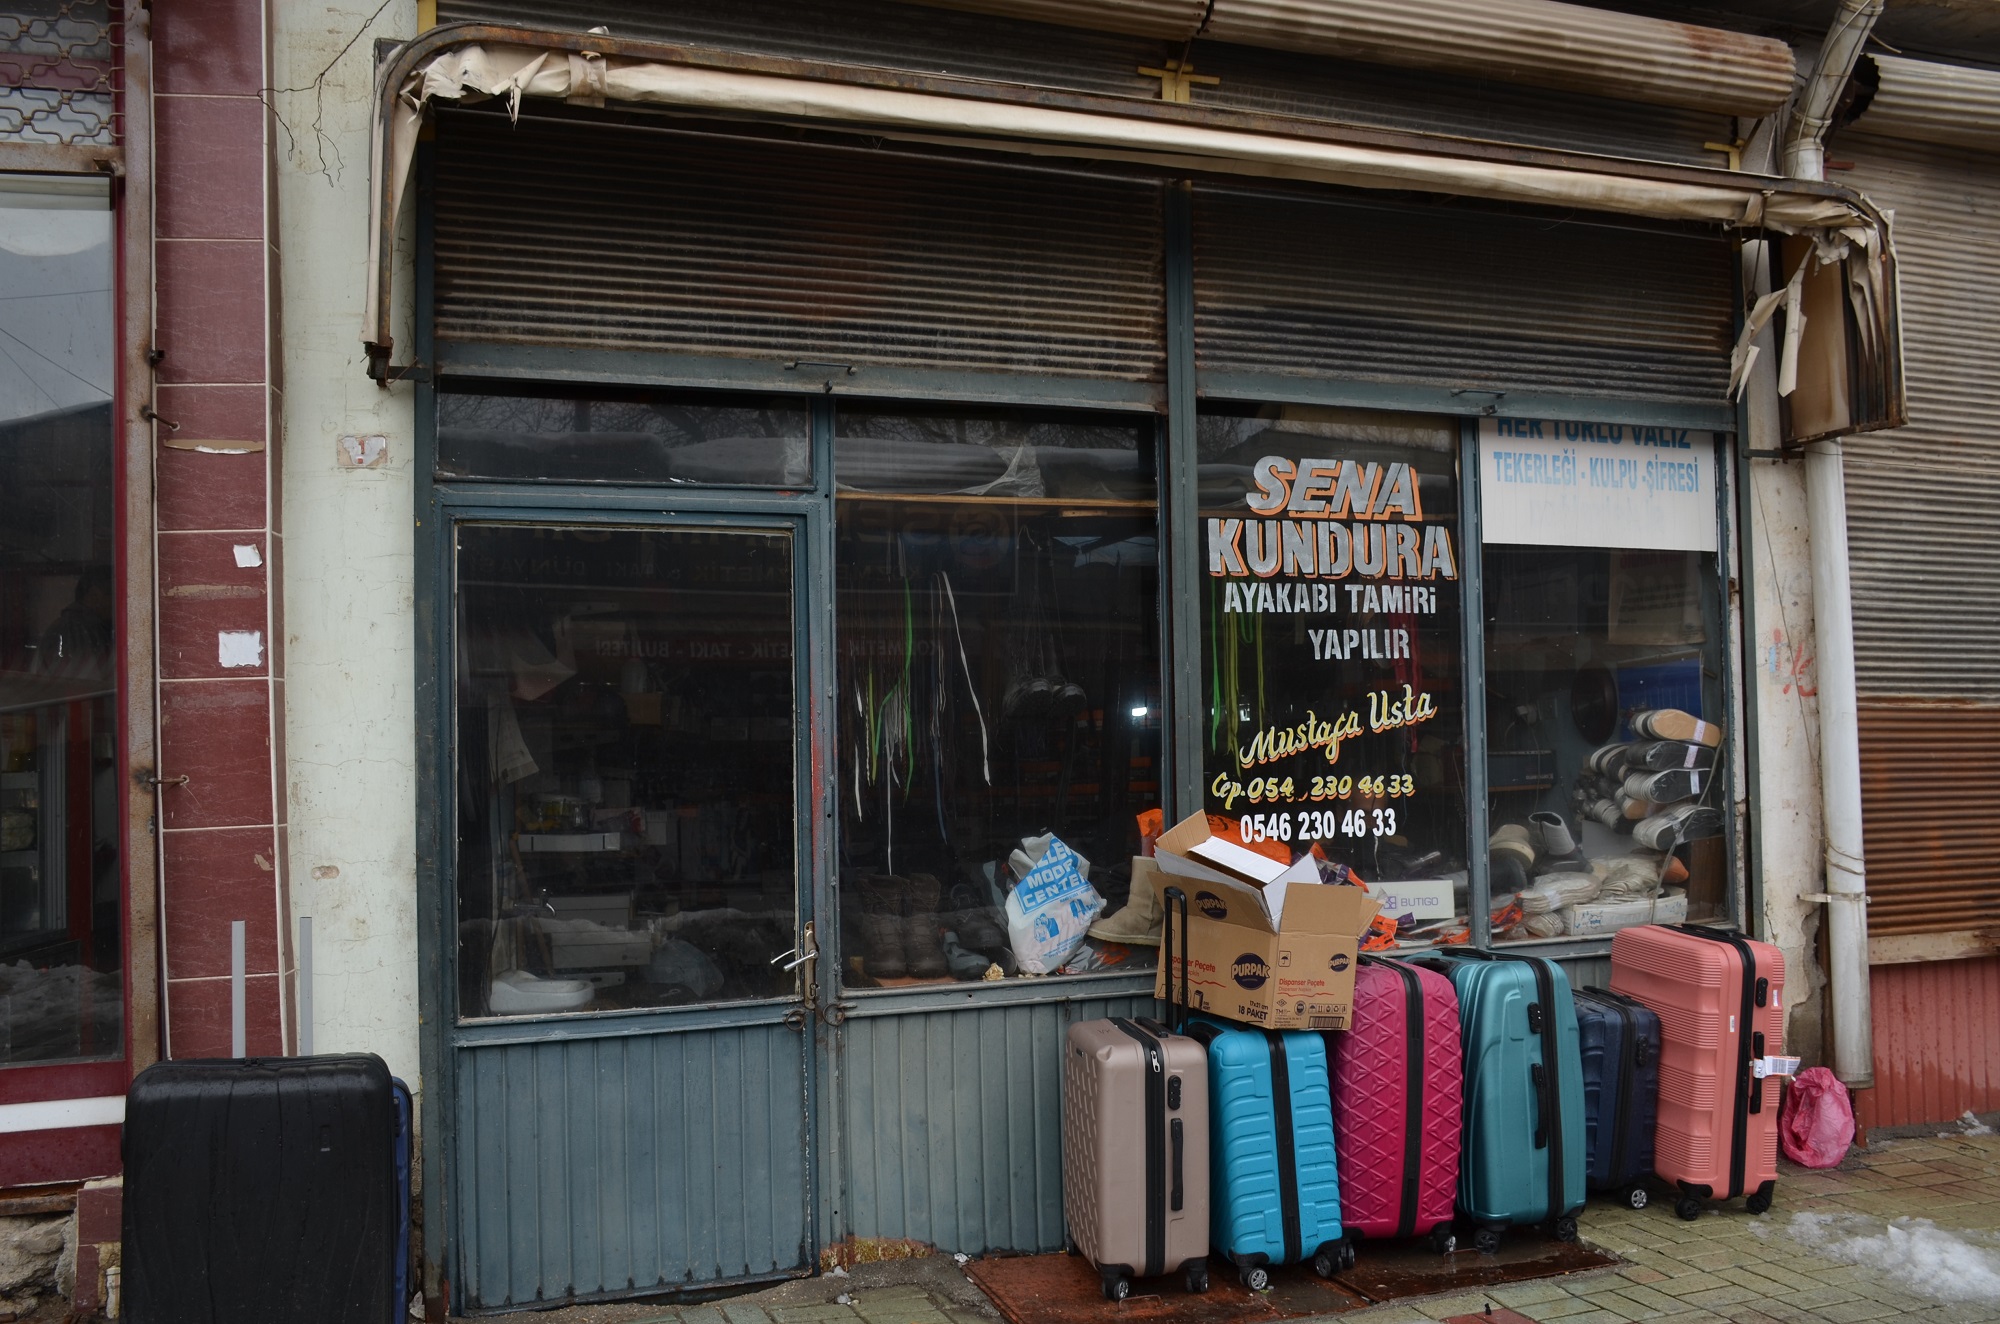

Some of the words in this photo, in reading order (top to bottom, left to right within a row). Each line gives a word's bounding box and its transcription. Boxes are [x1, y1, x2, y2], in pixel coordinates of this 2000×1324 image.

[1493, 448, 1577, 486] TEKERLEĞİ
[1589, 457, 1638, 490] KULPU
[1246, 455, 1422, 521] SENA
[1208, 518, 1459, 580] KUNDURA
[1224, 582, 1336, 613] AYAKABI
[1308, 629, 1410, 660] YAPILIR
[1239, 710, 1365, 768] Mustafa
[1367, 684, 1438, 733] Usta
[1311, 775, 1352, 802] 230
[1240, 812, 1292, 844] 0546
[1297, 810, 1336, 841] 230
[1341, 809, 1367, 838] 46
[1372, 807, 1397, 837] 33
[1195, 897, 1228, 912] PURPAK
[1400, 896, 1439, 907] BUTIGO
[1231, 960, 1271, 980] PURPAK
[1328, 954, 1350, 969] PURPAK
[1238, 1004, 1246, 1015] 18
[1246, 1007, 1269, 1020] PAKET
